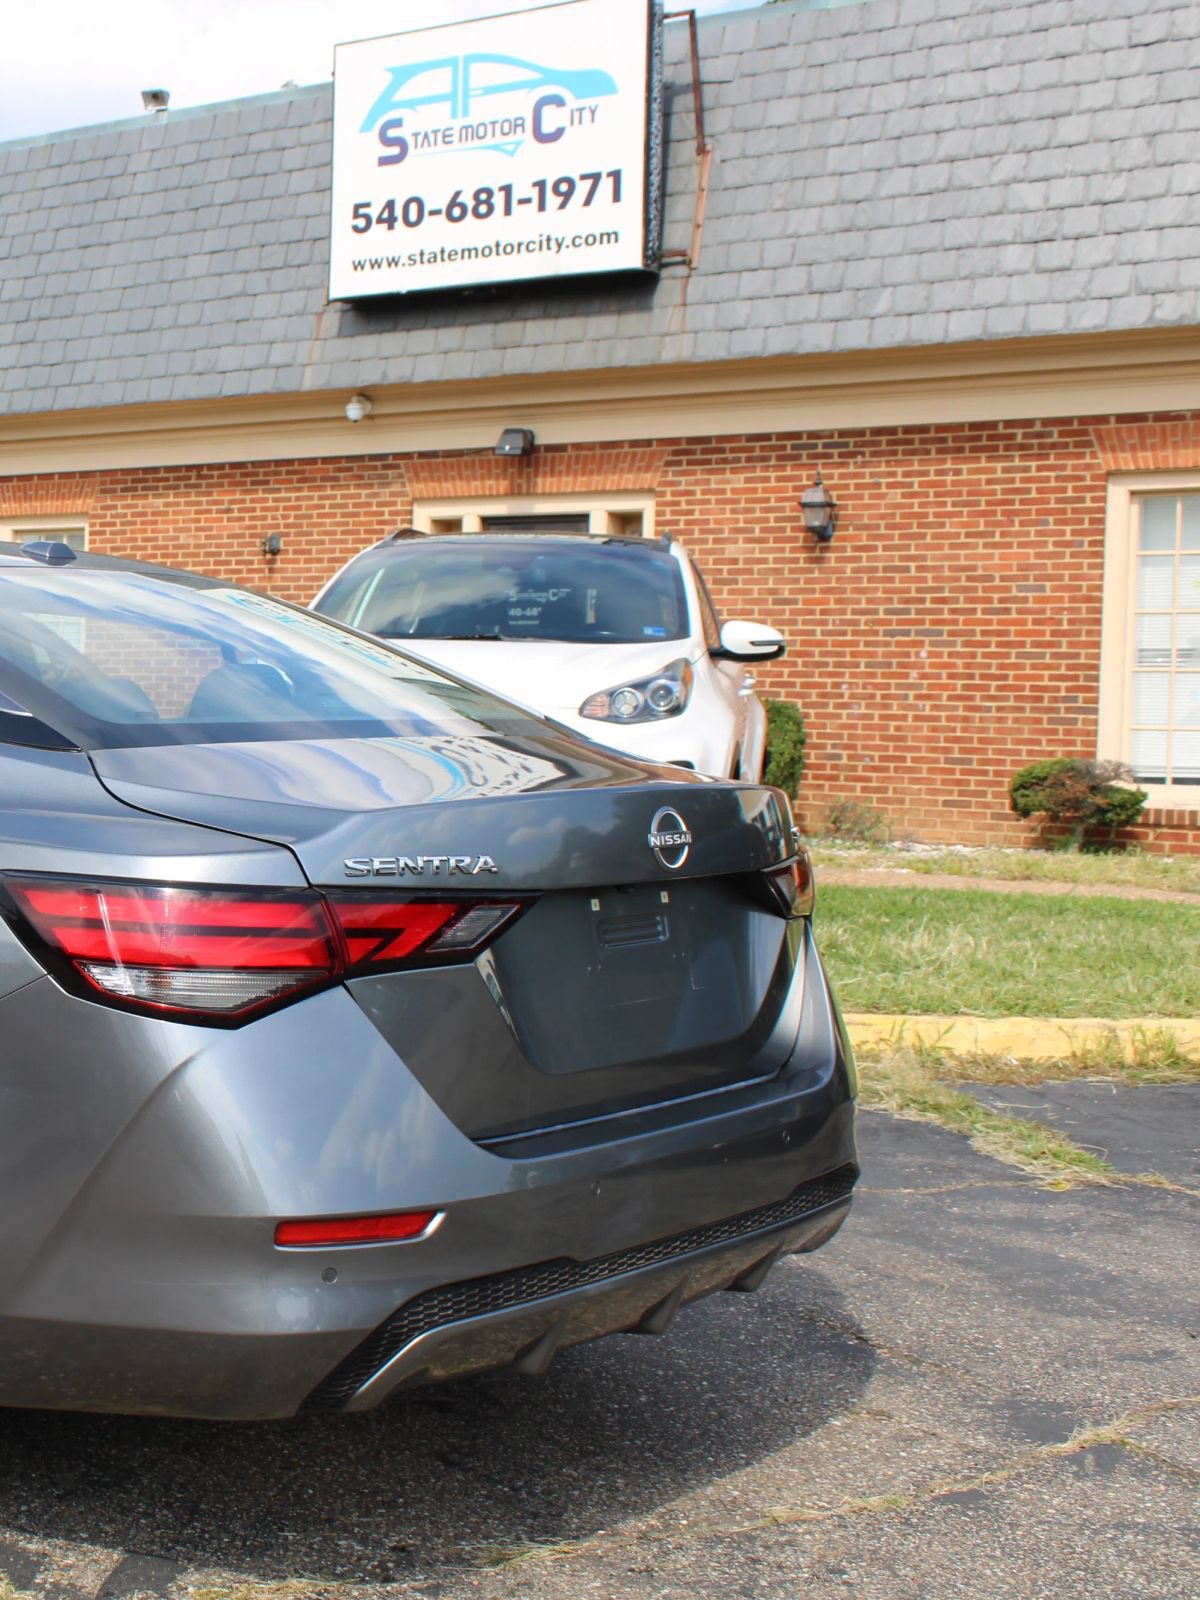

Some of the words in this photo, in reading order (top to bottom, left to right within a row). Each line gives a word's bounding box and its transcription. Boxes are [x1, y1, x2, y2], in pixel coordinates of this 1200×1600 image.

[377, 117, 454, 167] STATE
[458, 116, 527, 144] MOTOR
[531, 94, 599, 145] CITY
[351, 168, 623, 234] 540-681-1971
[351, 229, 620, 272] www.statemotorcity.com
[650, 833, 692, 846] NISSAN
[344, 855, 498, 877] SENTRA
